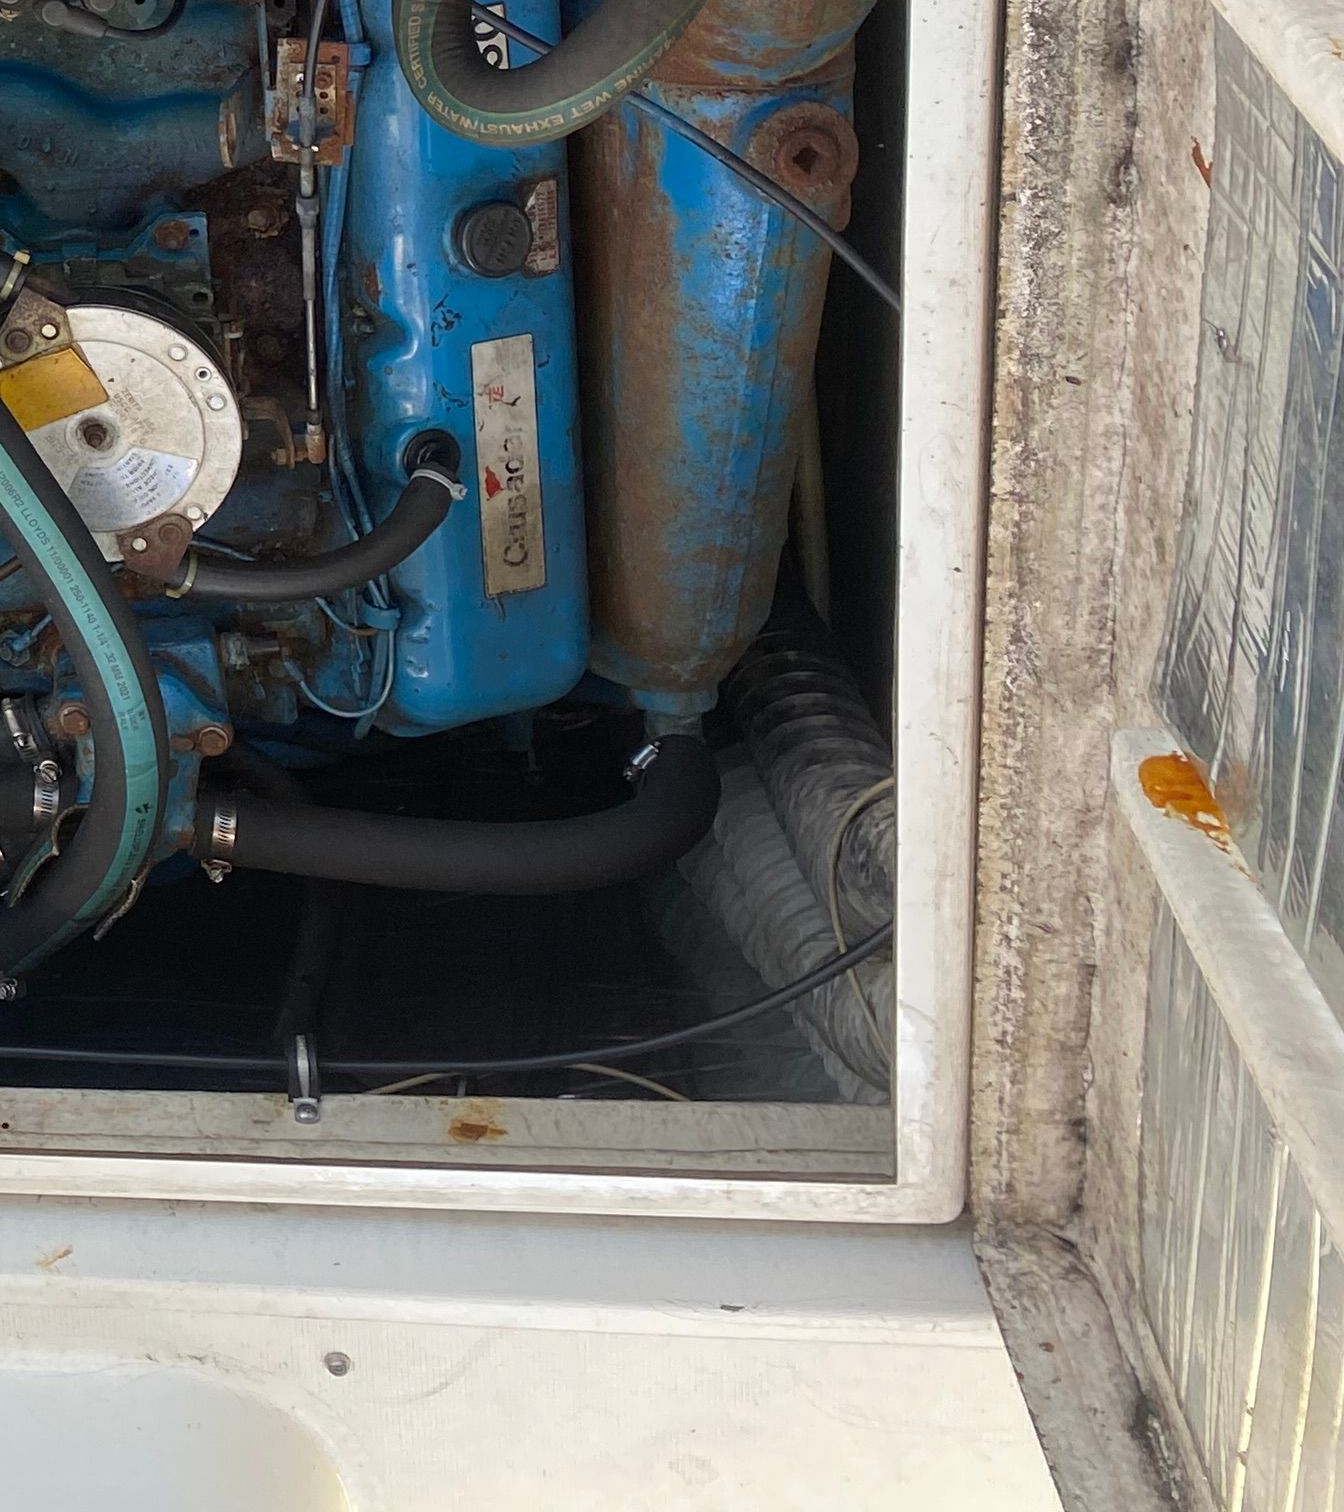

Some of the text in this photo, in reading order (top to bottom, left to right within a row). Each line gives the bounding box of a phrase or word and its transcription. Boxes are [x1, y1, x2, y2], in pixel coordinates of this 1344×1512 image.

[409, 16, 427, 90] CERTIFIED
[19, 507, 52, 547] LLOYDS
[45, 545, 74, 585] 11/00001
[68, 584, 97, 624] 250-1140
[110, 664, 124, 681] MM
[116, 681, 132, 701] 2021
